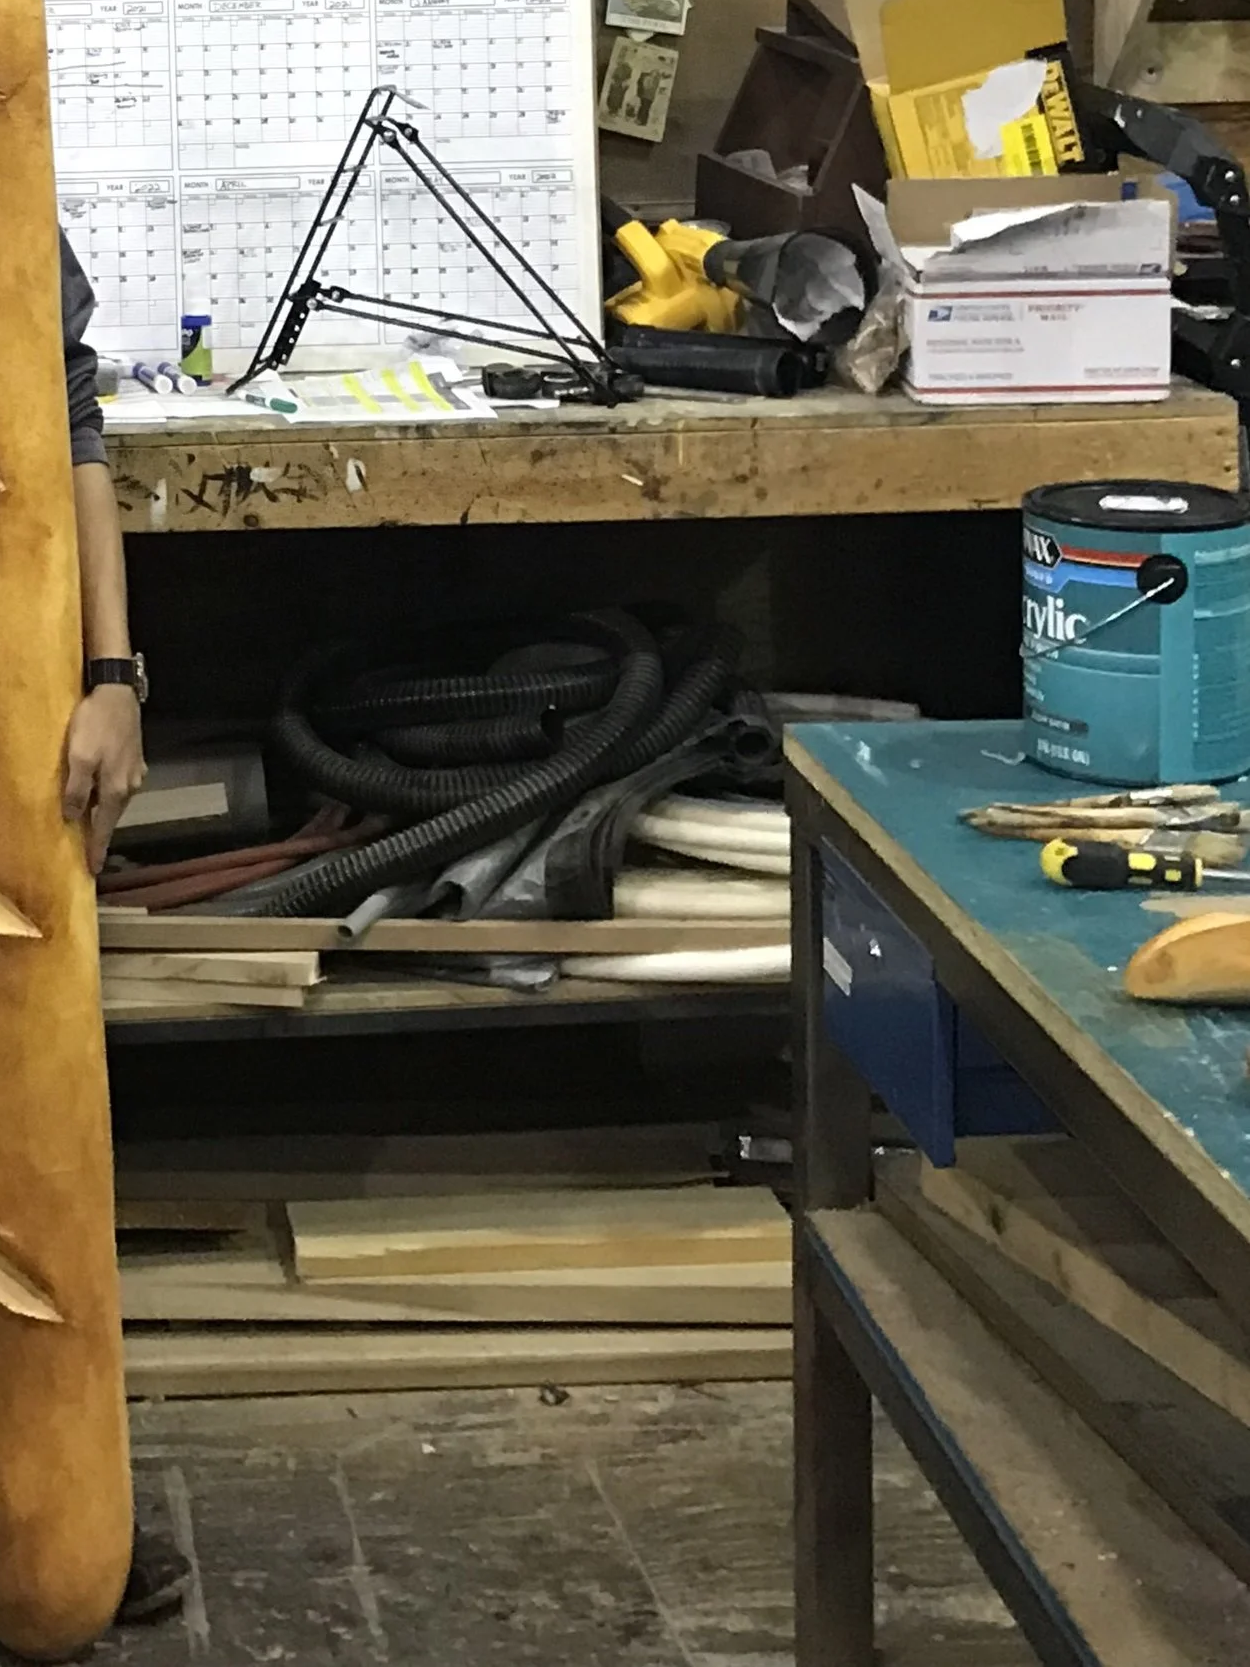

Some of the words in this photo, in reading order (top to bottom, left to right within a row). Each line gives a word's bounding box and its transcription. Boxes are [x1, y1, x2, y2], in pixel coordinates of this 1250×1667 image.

[126, 3, 147, 14] 2021
[213, 1, 262, 11] DECEMBER
[1042, 60, 1085, 167] DEWALT
[1023, 528, 1054, 564] WAX
[1023, 595, 1088, 645] rylic
